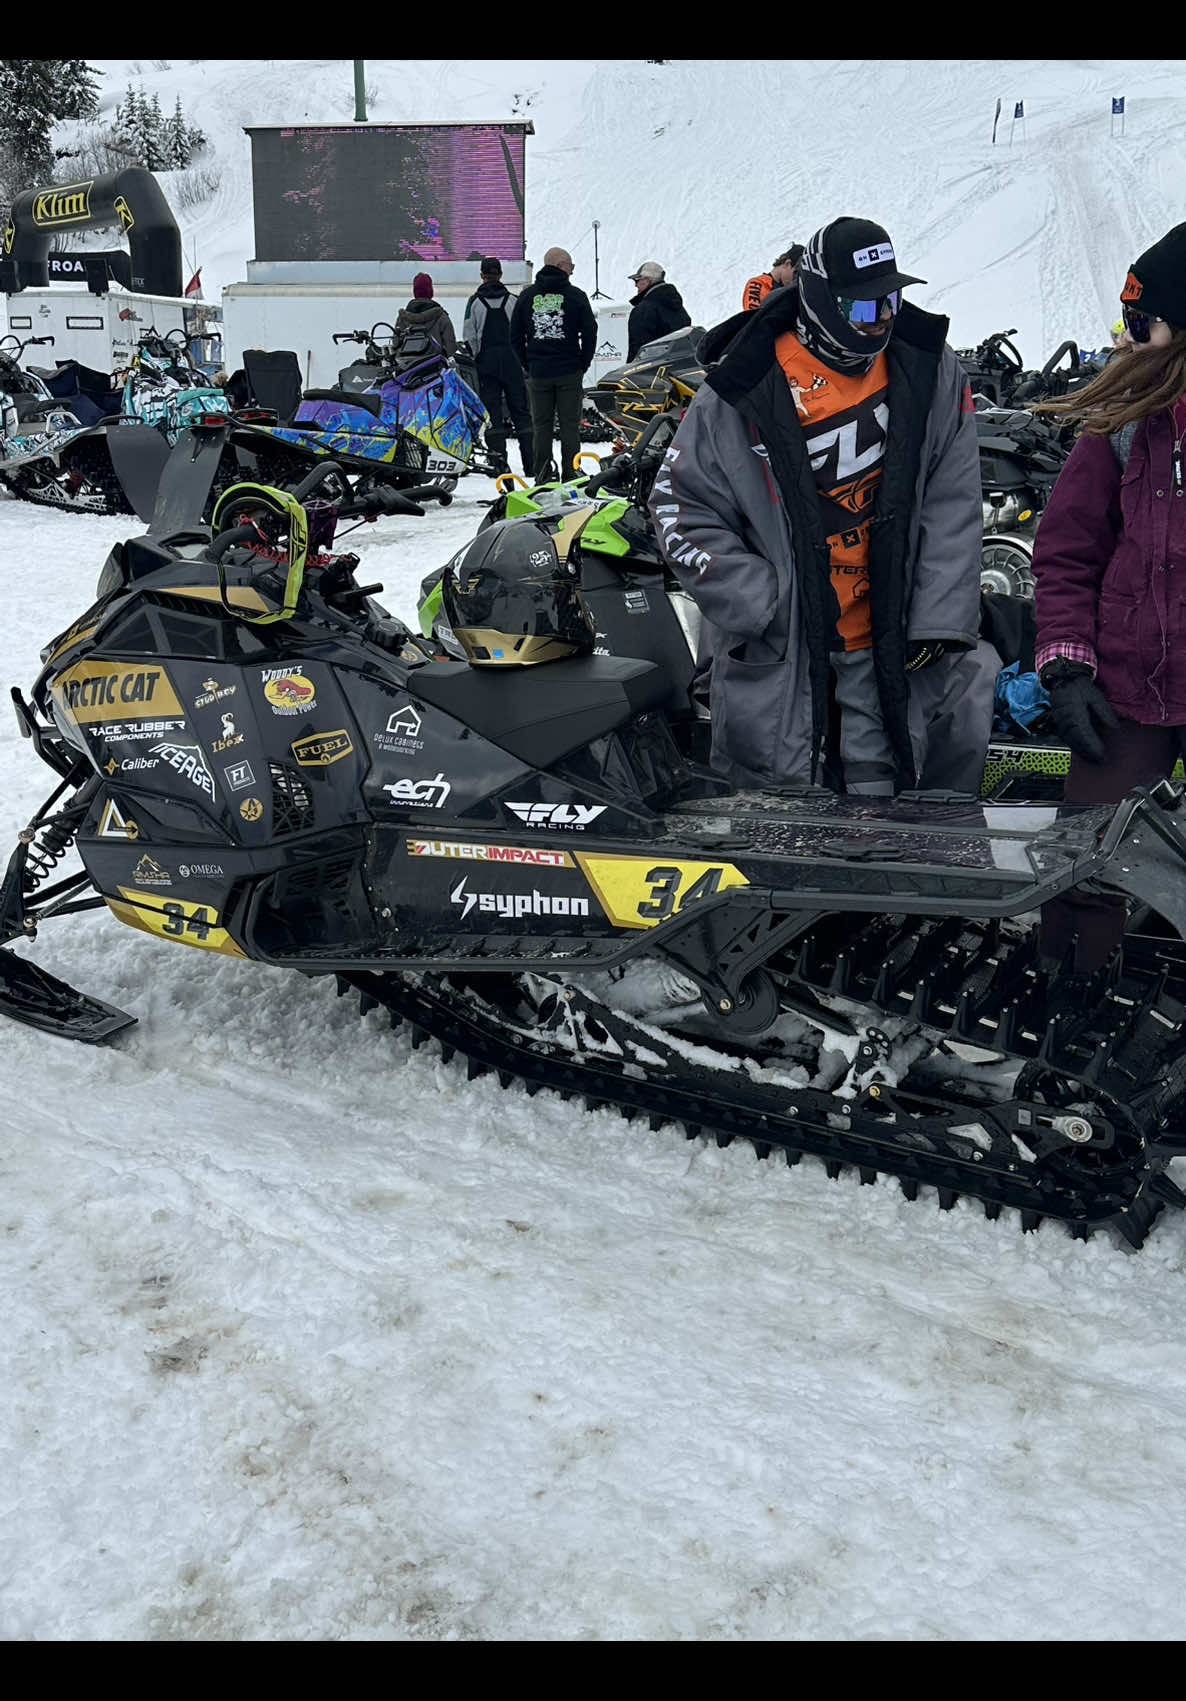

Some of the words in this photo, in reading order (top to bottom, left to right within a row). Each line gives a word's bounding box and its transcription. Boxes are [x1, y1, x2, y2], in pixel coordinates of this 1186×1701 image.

[36, 191, 87, 220] Klim
[48, 260, 84, 272] ROA
[428, 461, 456, 471] 303
[261, 665, 303, 683] WOODY'S
[63, 674, 118, 709] ARCTIC
[120, 671, 160, 703] CAT
[89, 725, 122, 737] RACE
[125, 721, 186, 733] RUBBER
[104, 732, 164, 742] COMPONENTS
[211, 734, 245, 753] Ibex
[298, 736, 348, 758] FUEL
[121, 758, 160, 771] Caliber
[504, 801, 609, 824] FLY
[526, 822, 586, 830] RACING
[191, 864, 224, 875] OMEGA
[637, 866, 724, 919] 34
[479, 889, 589, 918] syphon
[162, 902, 210, 940] 34
